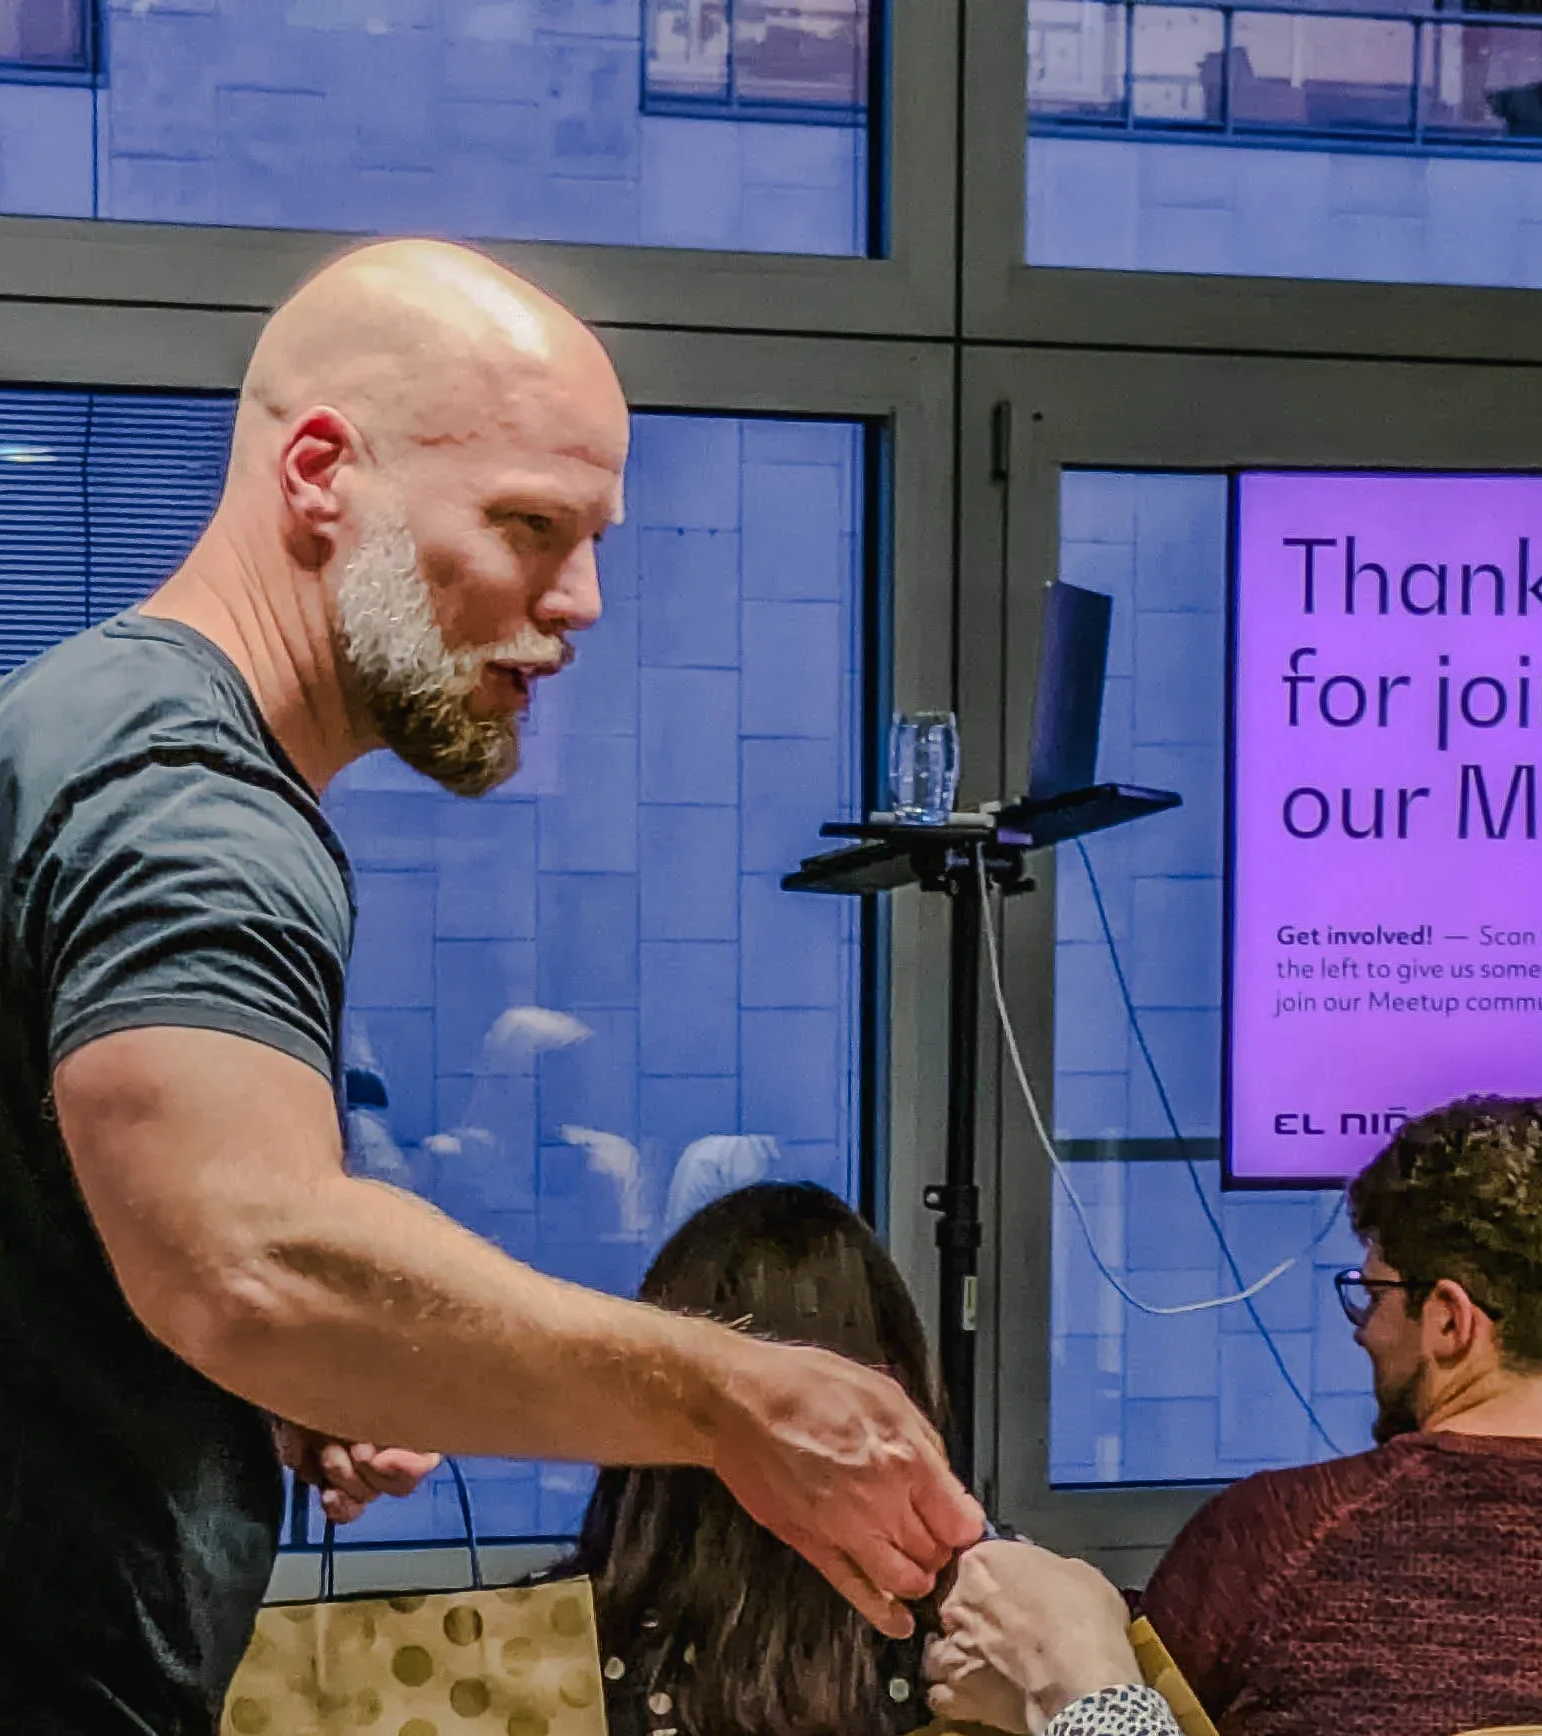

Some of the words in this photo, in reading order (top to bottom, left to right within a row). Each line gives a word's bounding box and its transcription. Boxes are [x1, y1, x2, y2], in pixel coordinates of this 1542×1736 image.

[1281, 646, 1412, 728] for
[1281, 786, 1431, 840] our
[1276, 925, 1321, 946] Get
[1327, 924, 1433, 946] involved!
[1479, 925, 1536, 946] Scan
[1277, 957, 1314, 979] the
[1321, 957, 1358, 979] left
[1367, 961, 1391, 979] to
[1396, 958, 1444, 985] give
[1450, 962, 1475, 979] us
[1480, 962, 1542, 979] some
[1274, 991, 1316, 1017] join
[1323, 997, 1361, 1012] our
[1368, 991, 1459, 1017] Meetup
[1274, 1113, 1325, 1135] EL
[1340, 1106, 1409, 1135] NIÑ
